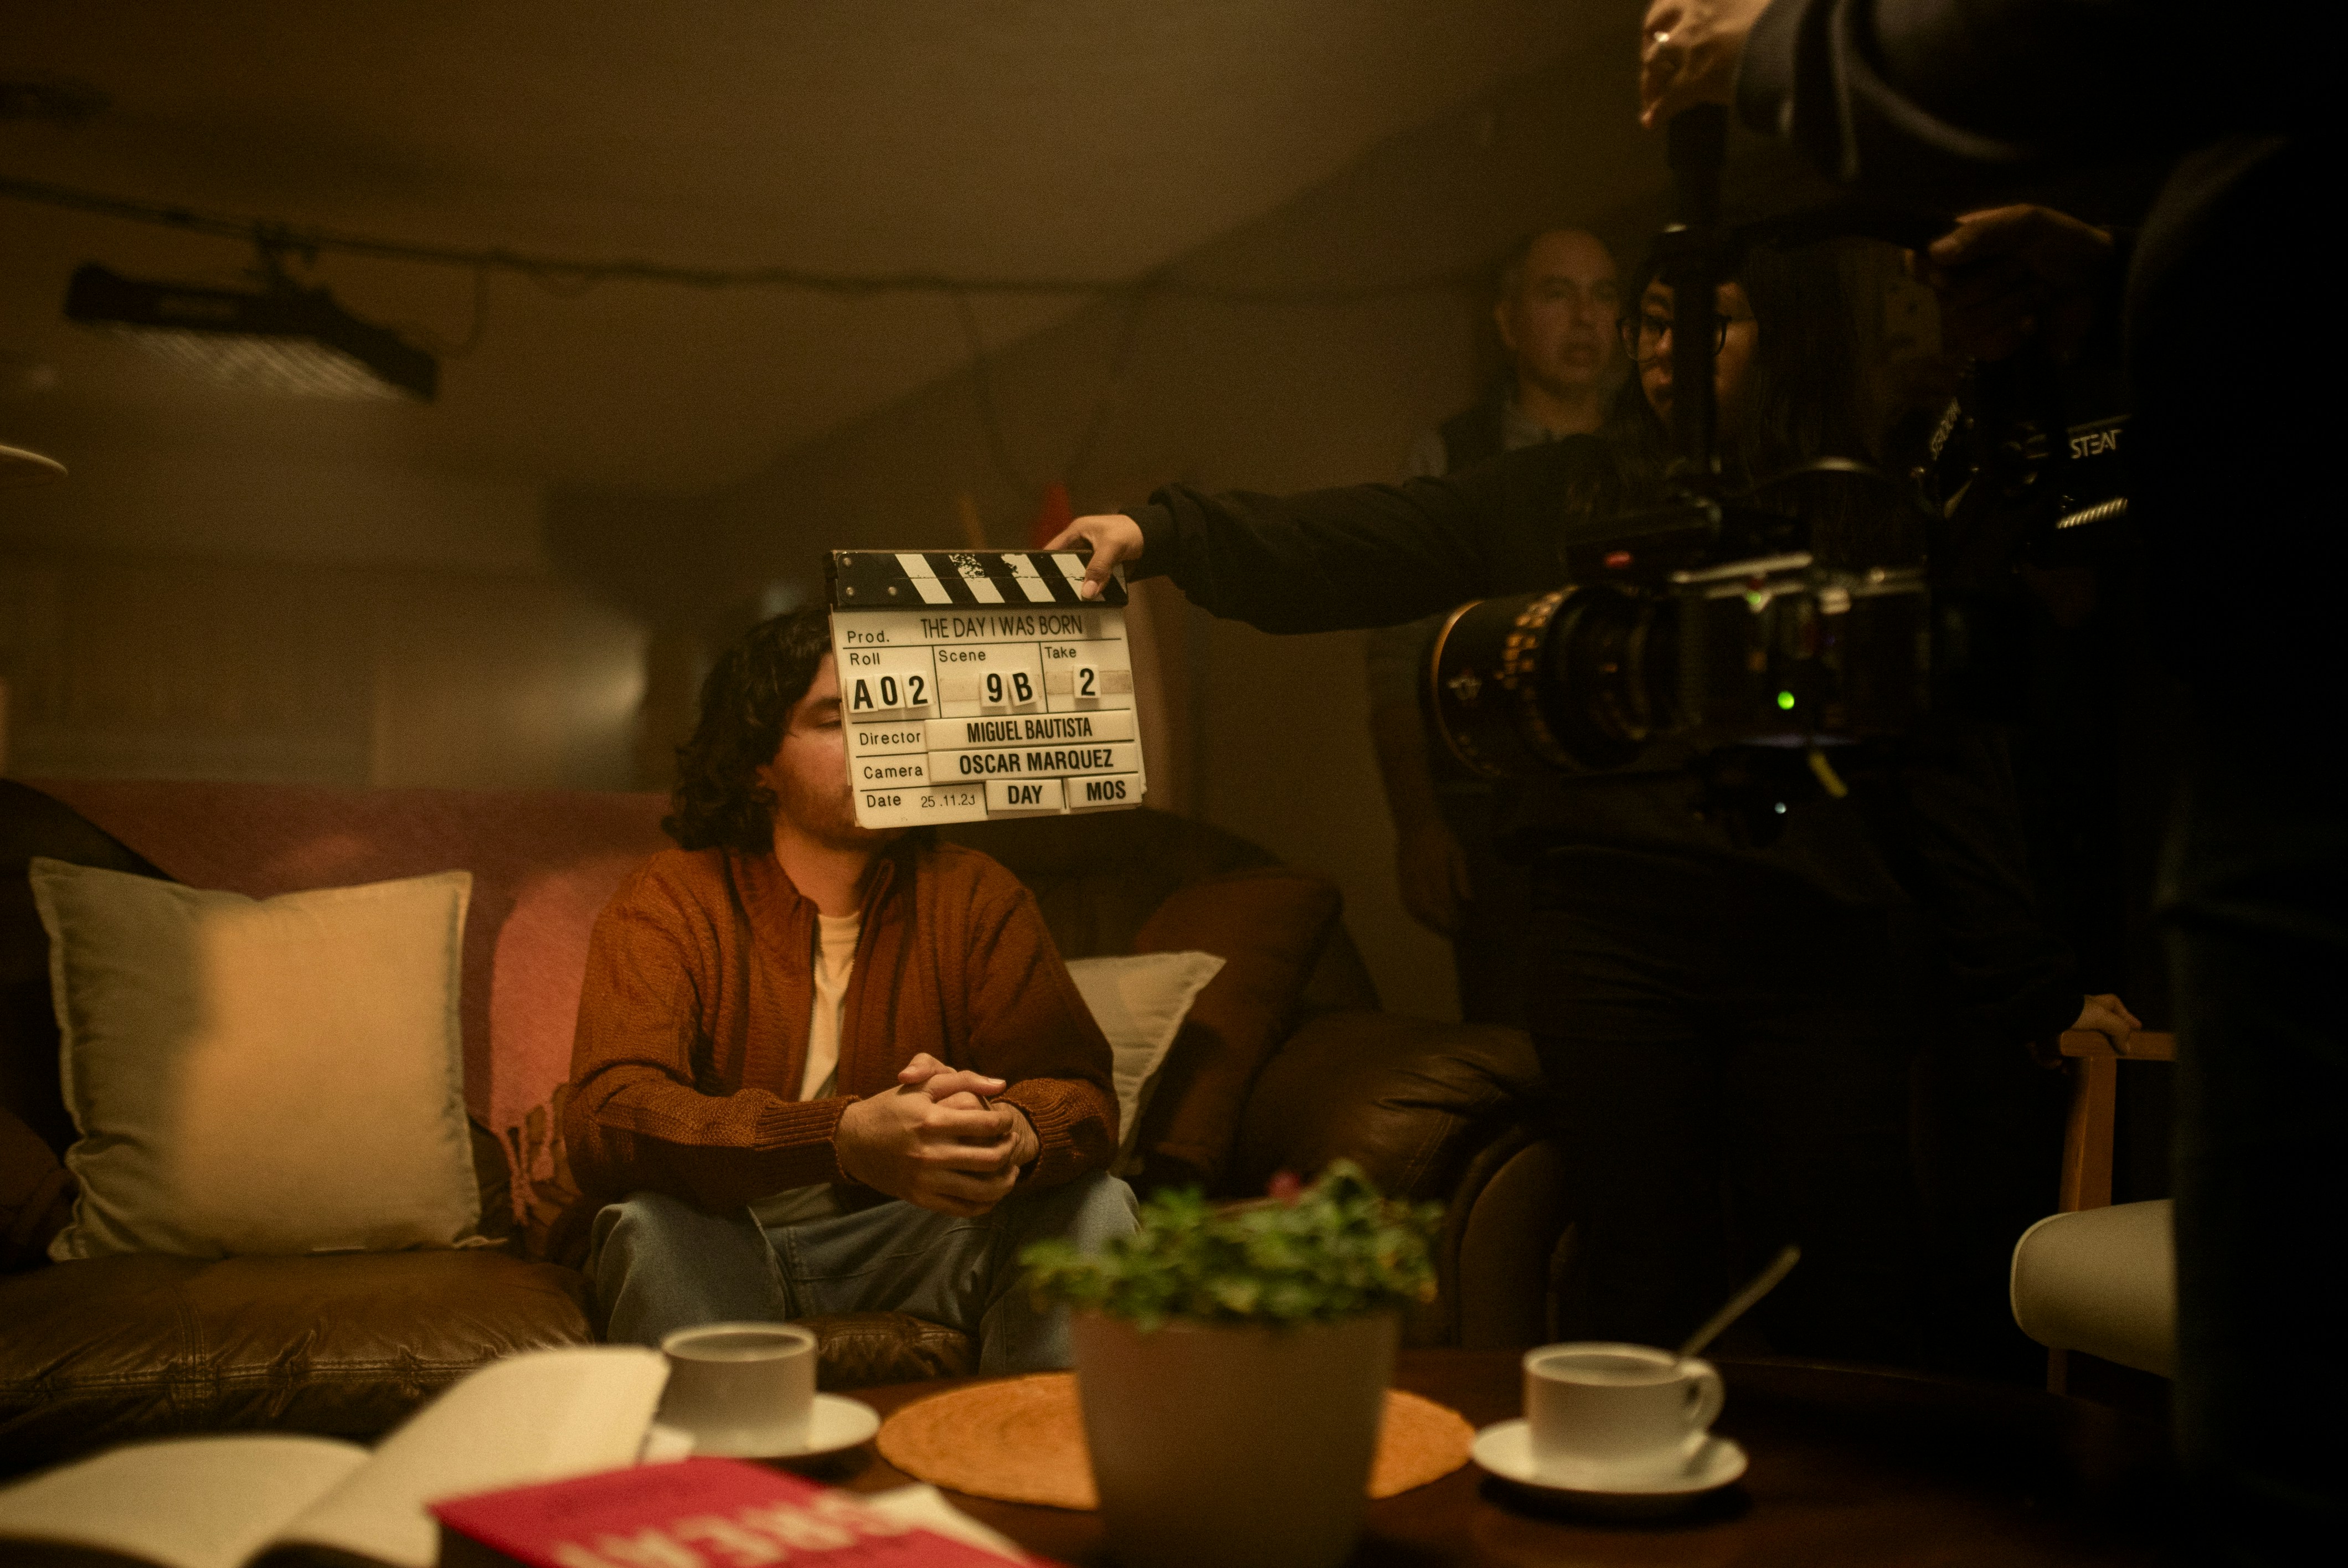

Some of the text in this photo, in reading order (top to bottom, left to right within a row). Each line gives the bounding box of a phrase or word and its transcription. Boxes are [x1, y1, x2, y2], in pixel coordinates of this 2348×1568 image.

[920, 615, 1083, 638] THE DAY I WAS BORN
[847, 630, 889, 643] Prod.
[849, 653, 880, 666] Roll
[939, 649, 986, 663] Scene
[1044, 646, 1077, 659] Take
[1079, 668, 1096, 697] 2
[967, 717, 1093, 743] MIGUEL BAUTISTA
[859, 733, 920, 746] Director
[959, 749, 1114, 775] OSCAR MARQUEZ
[863, 766, 923, 780] Camera
[1007, 785, 1043, 804] DAY
[1087, 780, 1126, 801] MOS
[866, 795, 901, 808] Date
